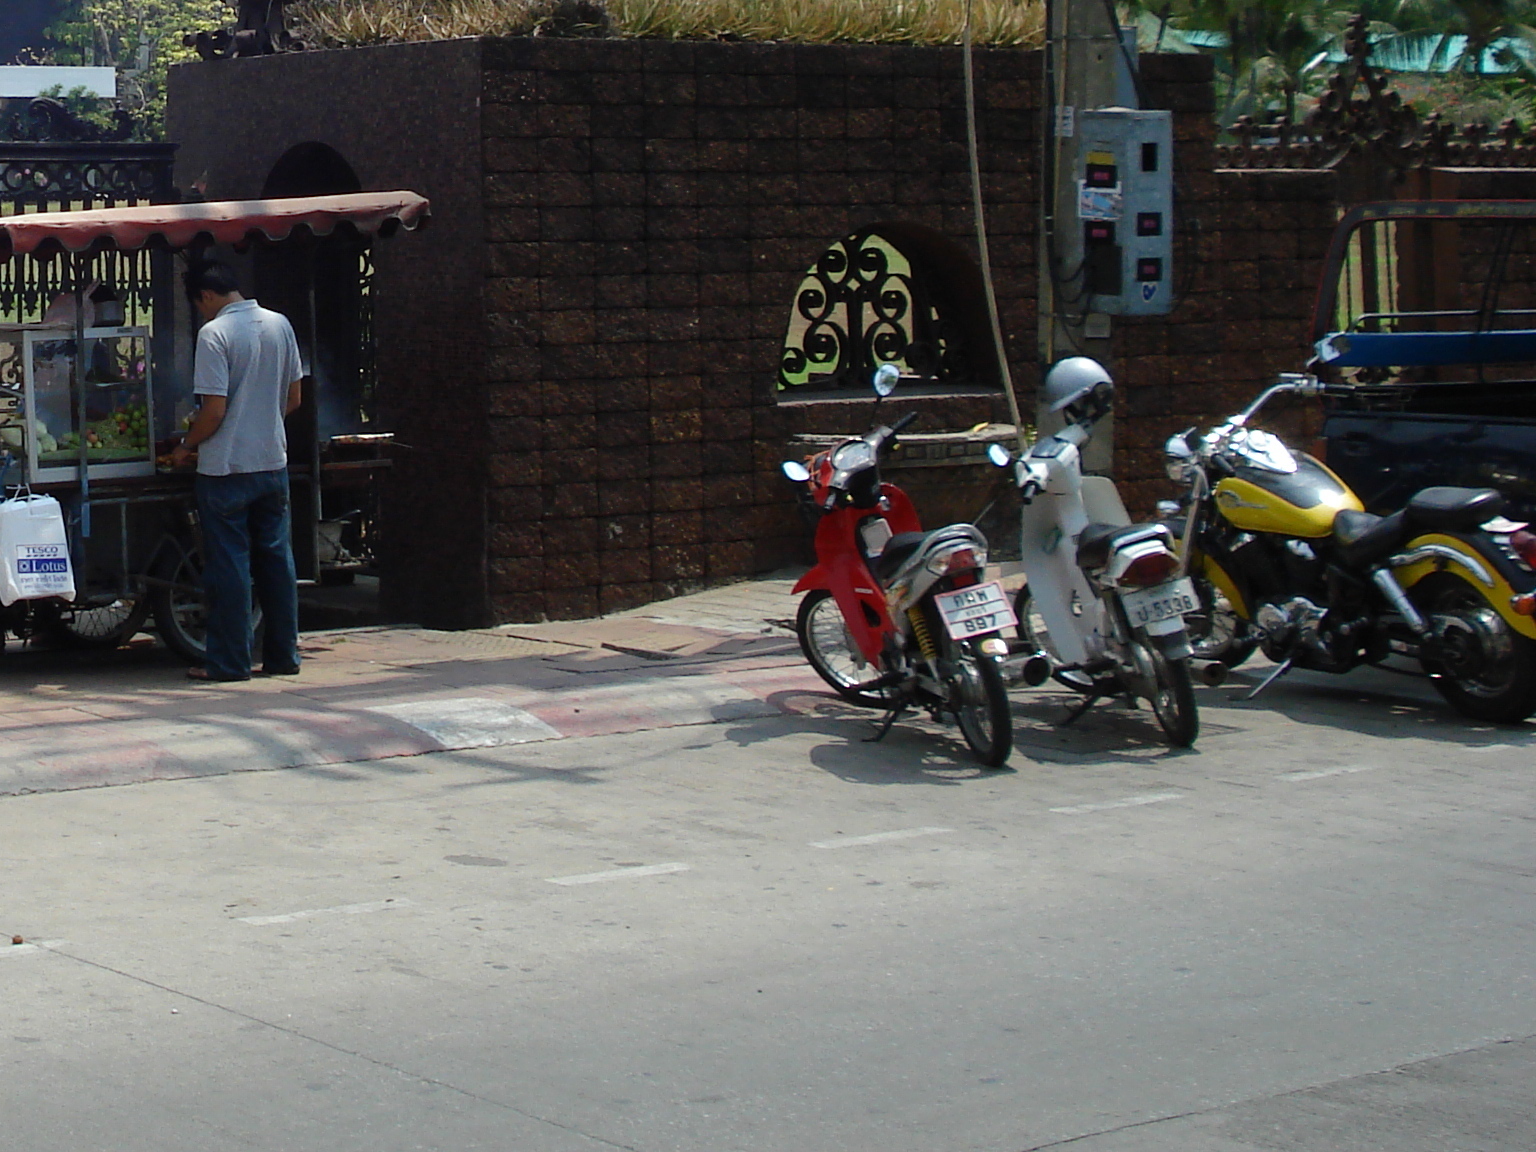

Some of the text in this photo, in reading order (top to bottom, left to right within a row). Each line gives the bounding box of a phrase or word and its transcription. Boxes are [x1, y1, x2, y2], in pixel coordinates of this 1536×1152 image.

[26, 546, 59, 554] TESCO
[32, 559, 66, 572] Lotus
[965, 614, 996, 632] 897
